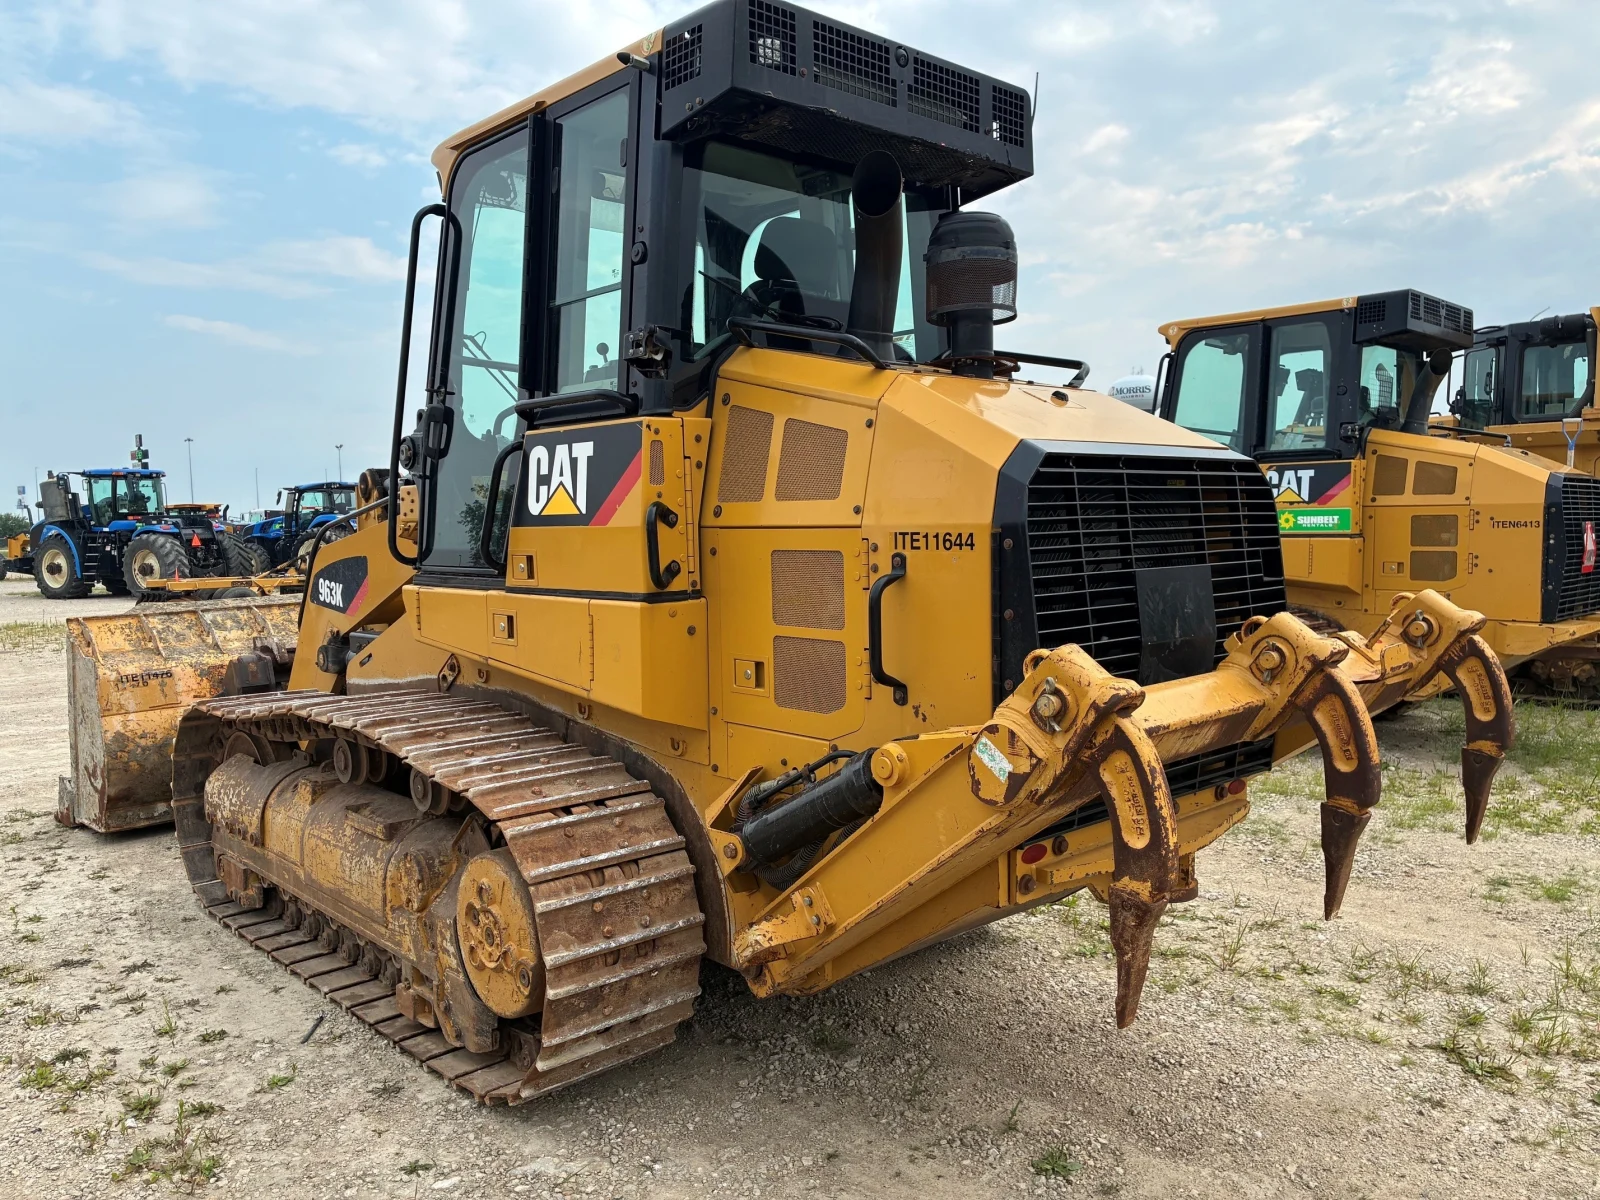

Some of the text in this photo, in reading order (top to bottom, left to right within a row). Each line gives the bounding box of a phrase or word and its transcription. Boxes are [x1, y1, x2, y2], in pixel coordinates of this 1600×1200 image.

[1115, 385, 1152, 396] MORRIS
[527, 441, 594, 516] CAT
[1265, 469, 1315, 502] CAT
[1297, 515, 1340, 525] SUNBELT
[1492, 520, 1540, 529] ITEN6413
[894, 531, 975, 551] ITE11644
[318, 577, 344, 608] 963K
